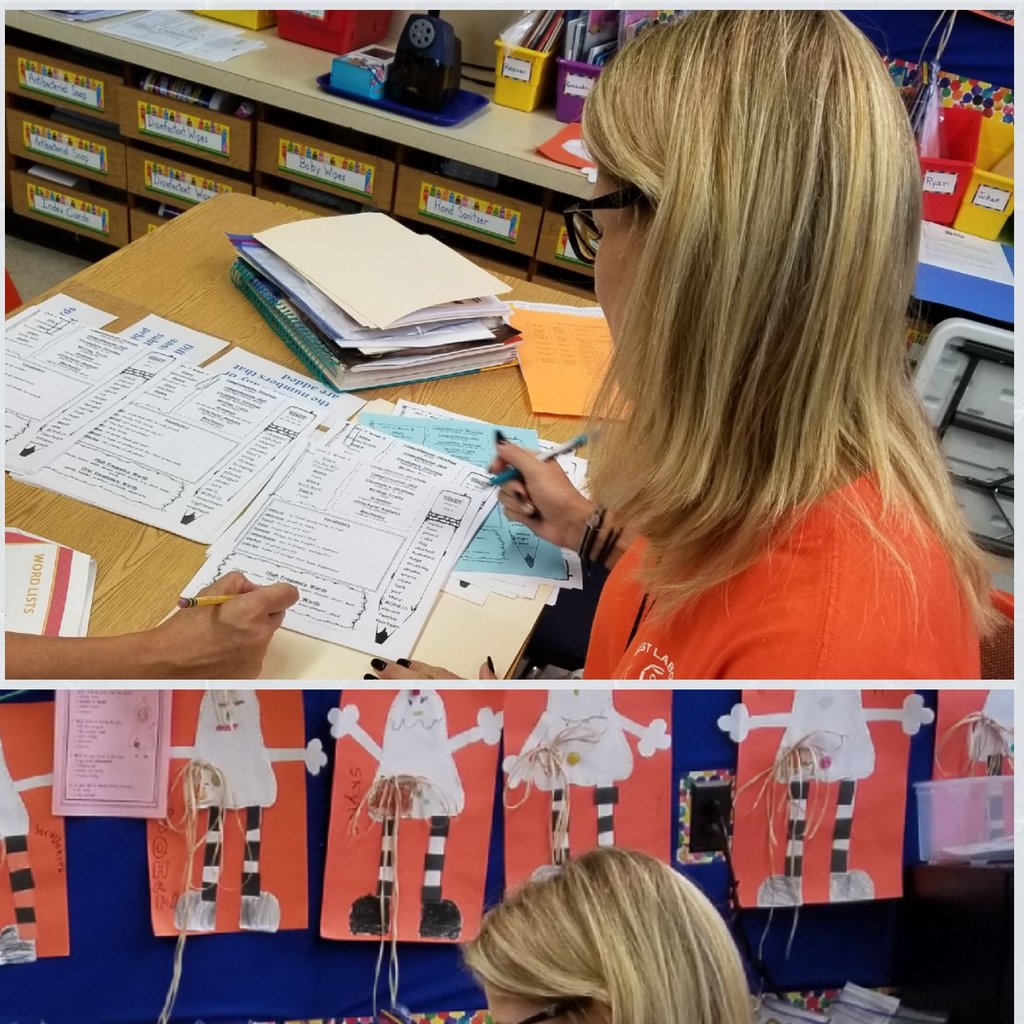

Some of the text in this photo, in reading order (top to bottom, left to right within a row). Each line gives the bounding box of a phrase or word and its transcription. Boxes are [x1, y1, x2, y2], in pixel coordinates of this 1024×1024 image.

[188, 130, 208, 144] Wipes
[299, 156, 346, 182] Baby Wipes
[926, 176, 949, 187] Ryan
[434, 199, 454, 216] Hand
[233, 364, 257, 378] that
[258, 374, 309, 397] numbers
[281, 374, 317, 390] added
[23, 553, 45, 614] WORD LISTS
